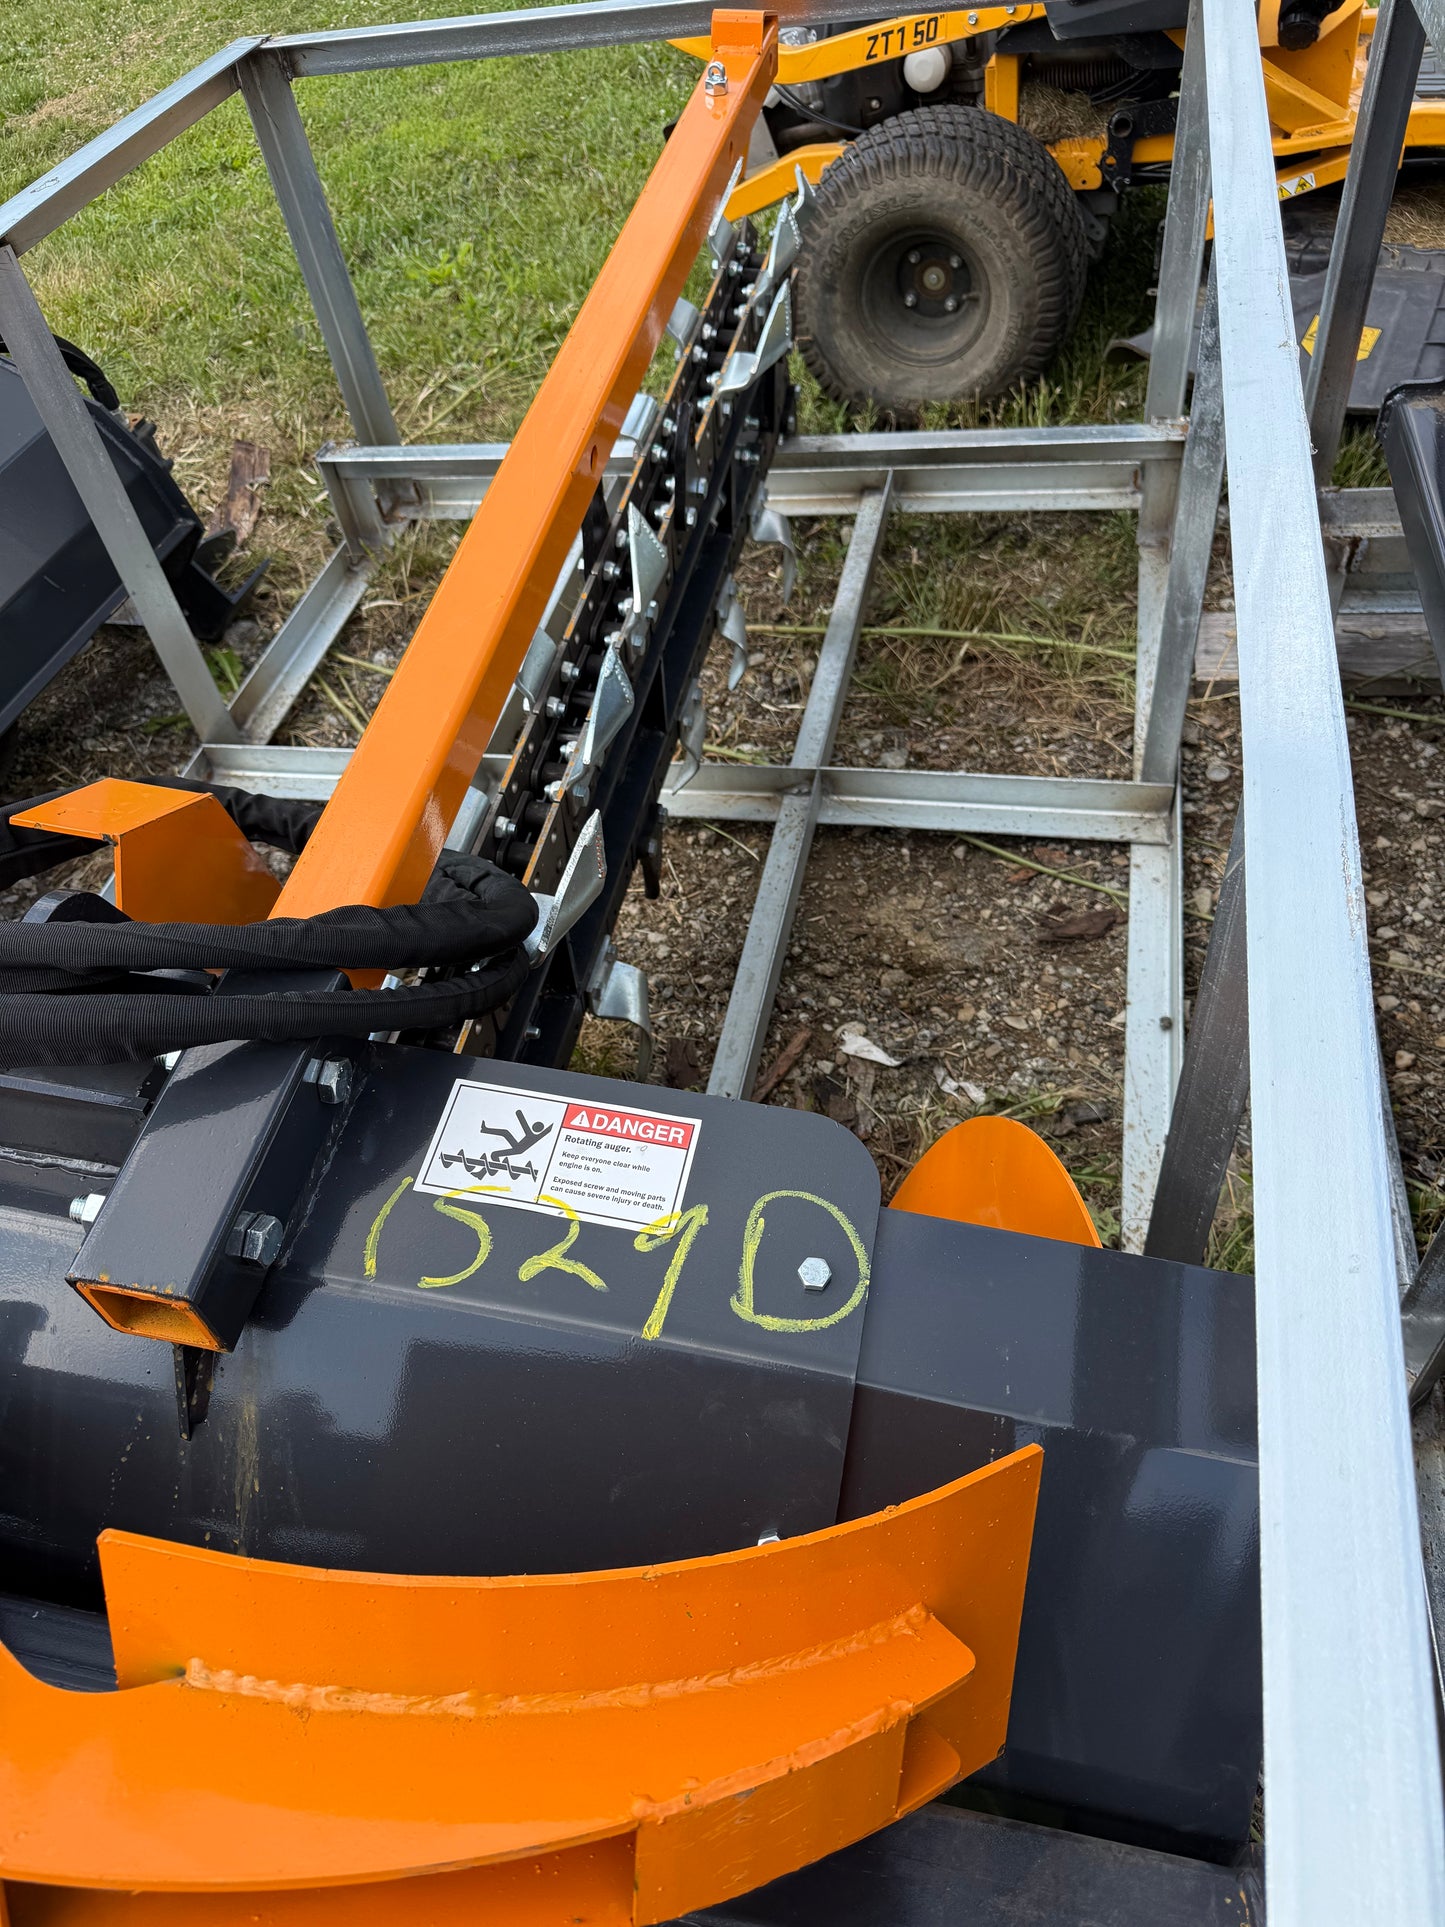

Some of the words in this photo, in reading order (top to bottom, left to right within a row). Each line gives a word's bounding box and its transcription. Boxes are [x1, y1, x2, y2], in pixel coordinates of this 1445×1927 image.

[866, 26, 905, 60] ZT1
[592, 1113, 685, 1144] DANGER
[564, 1134, 604, 1150] Rotating
[604, 1142, 632, 1153] auger.
[559, 1161, 582, 1170] engine
[562, 1151, 579, 1160] Keep
[581, 1154, 611, 1166] everyone
[613, 1160, 630, 1169] clear
[632, 1164, 651, 1173] while
[550, 1185, 563, 1193] can
[564, 1188, 586, 1197] cause
[587, 1192, 610, 1201] severe
[611, 1195, 632, 1206] injury
[642, 1200, 665, 1211] death.
[553, 1176, 582, 1187] Exposed
[583, 1182, 605, 1191] screw
[605, 1185, 619, 1194] and
[620, 1188, 646, 1200] moving
[647, 1193, 666, 1203] parts
